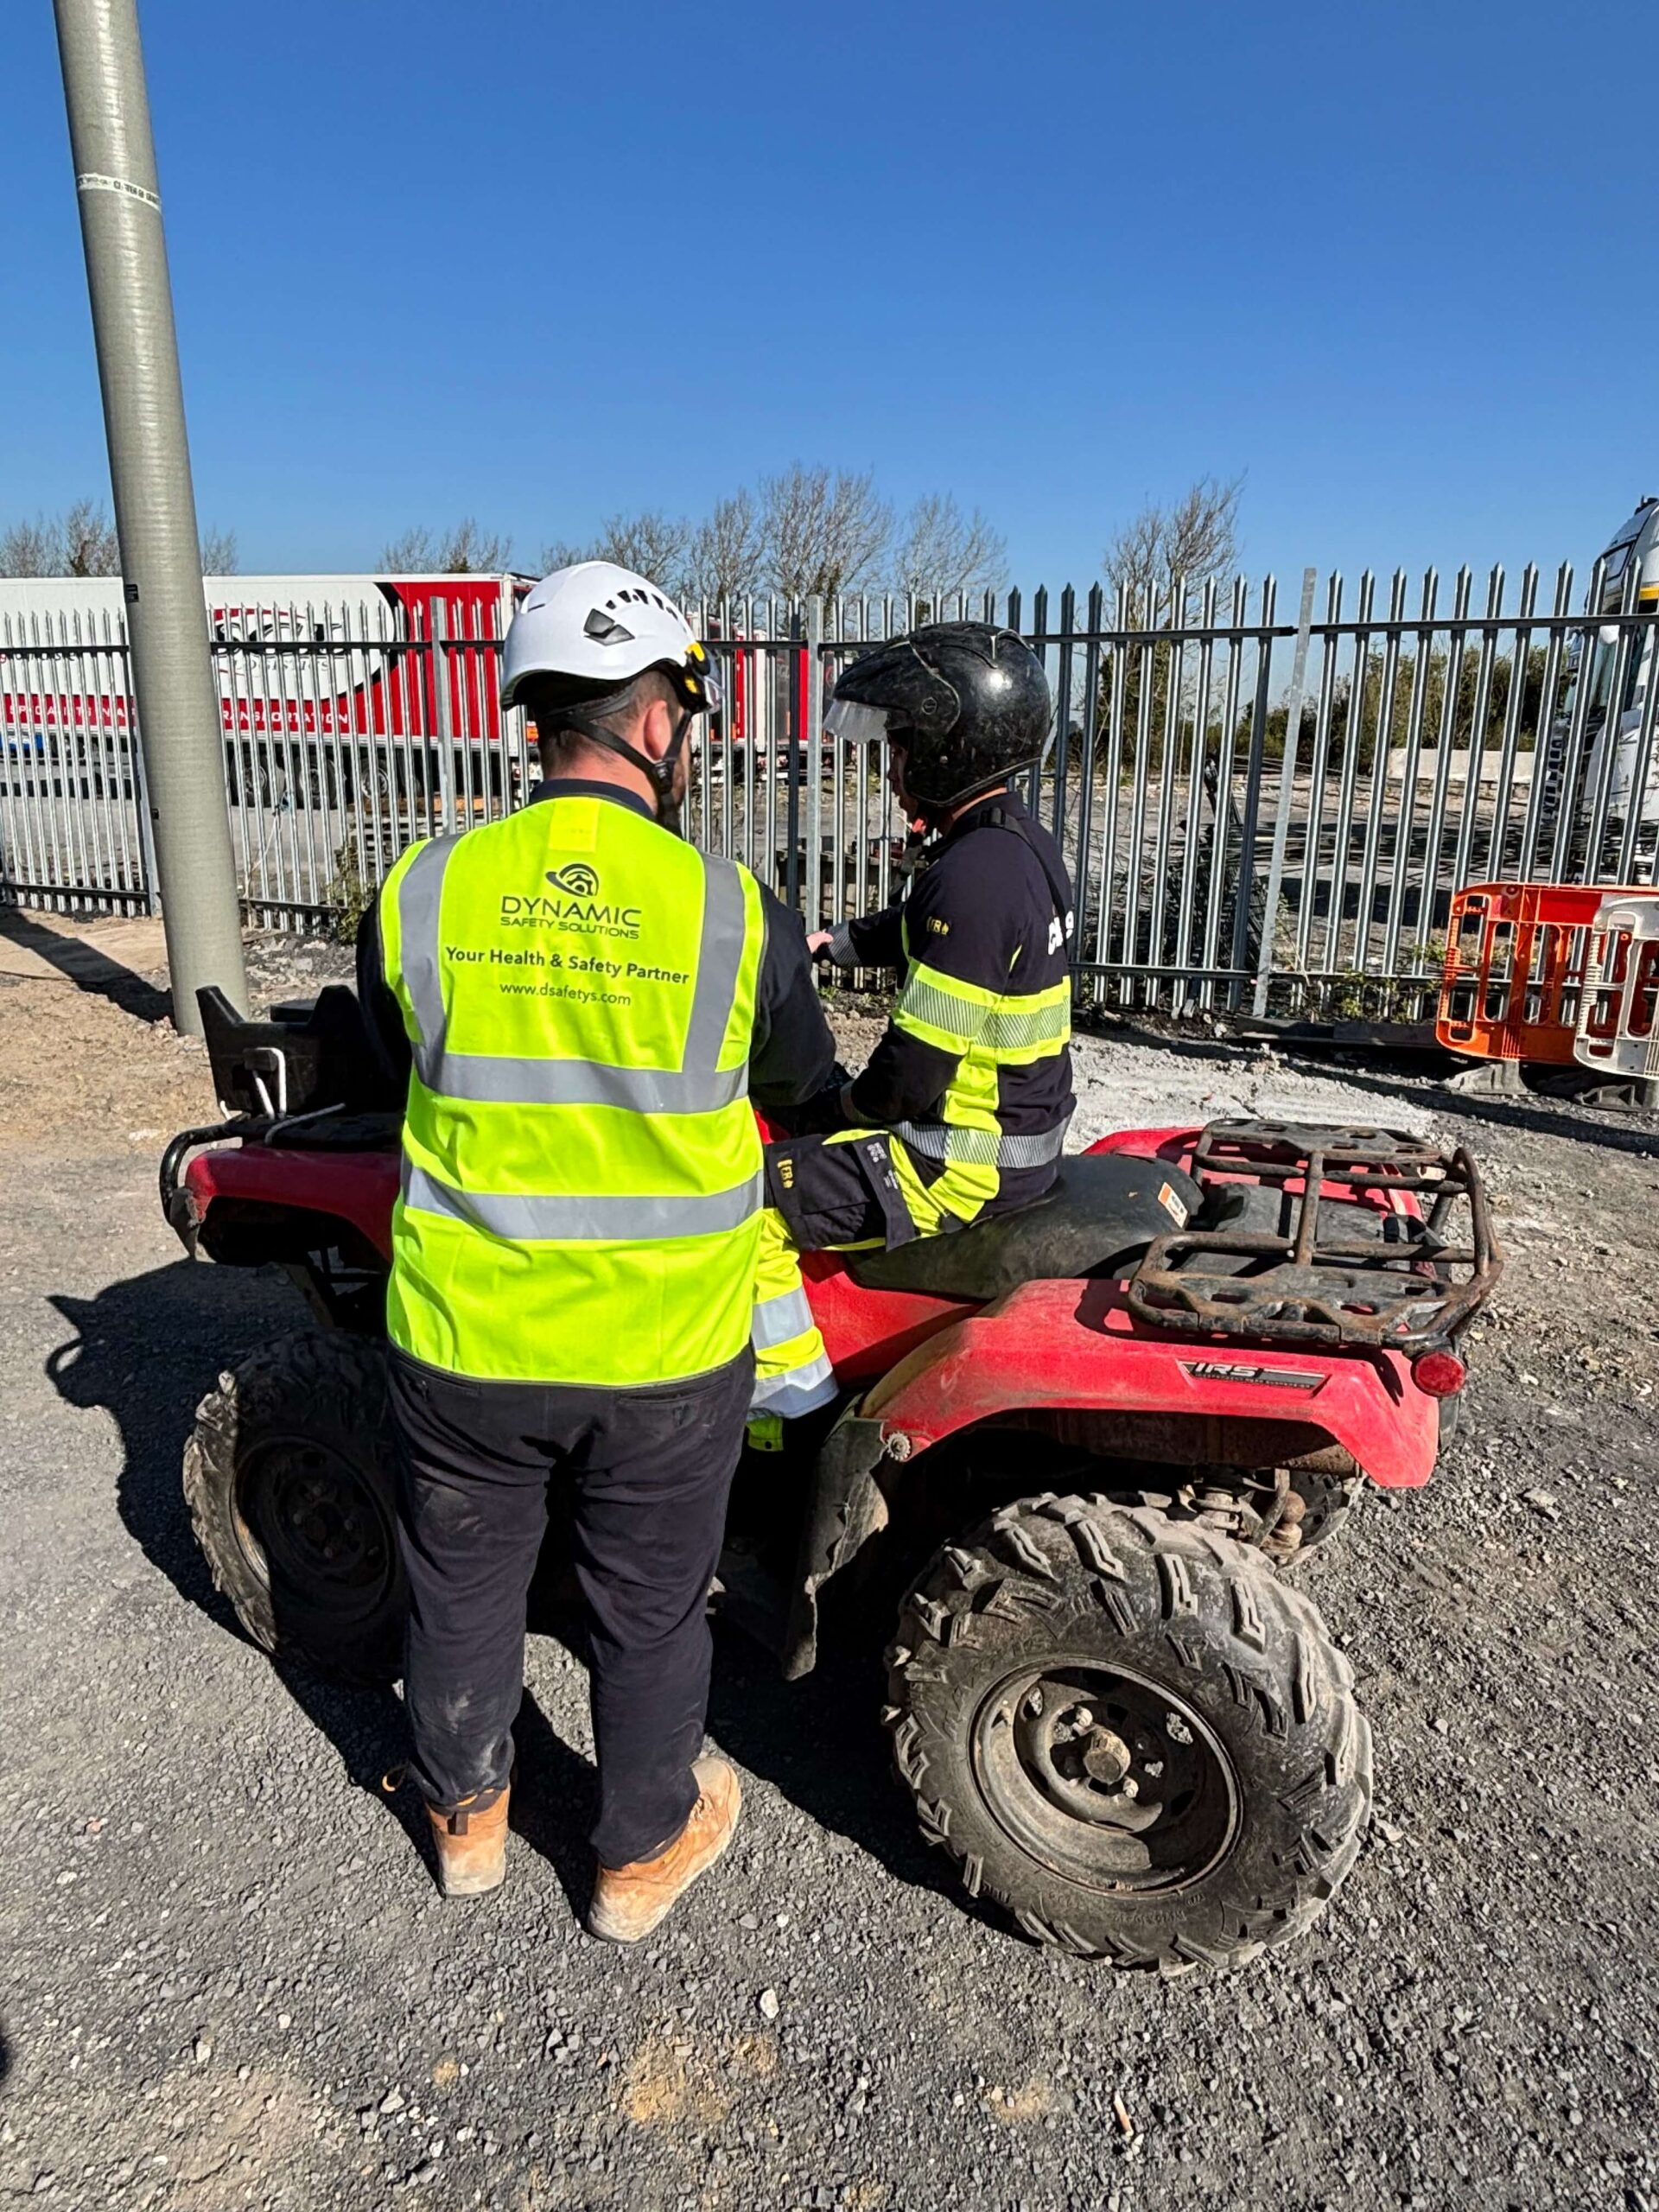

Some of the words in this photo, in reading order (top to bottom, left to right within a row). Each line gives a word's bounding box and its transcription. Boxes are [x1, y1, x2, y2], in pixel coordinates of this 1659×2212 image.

[501, 896, 641, 927] DYNAMIC
[500, 917, 555, 929] SAFETY
[558, 921, 639, 939] SOLUTIONS
[446, 946, 486, 963] Your
[490, 949, 545, 966] Health
[550, 953, 563, 968] &
[569, 956, 622, 978] Safety
[626, 963, 690, 984] Partner
[499, 982, 632, 1006] www.dsafetys.com
[1195, 1362, 1259, 1377] IRS
